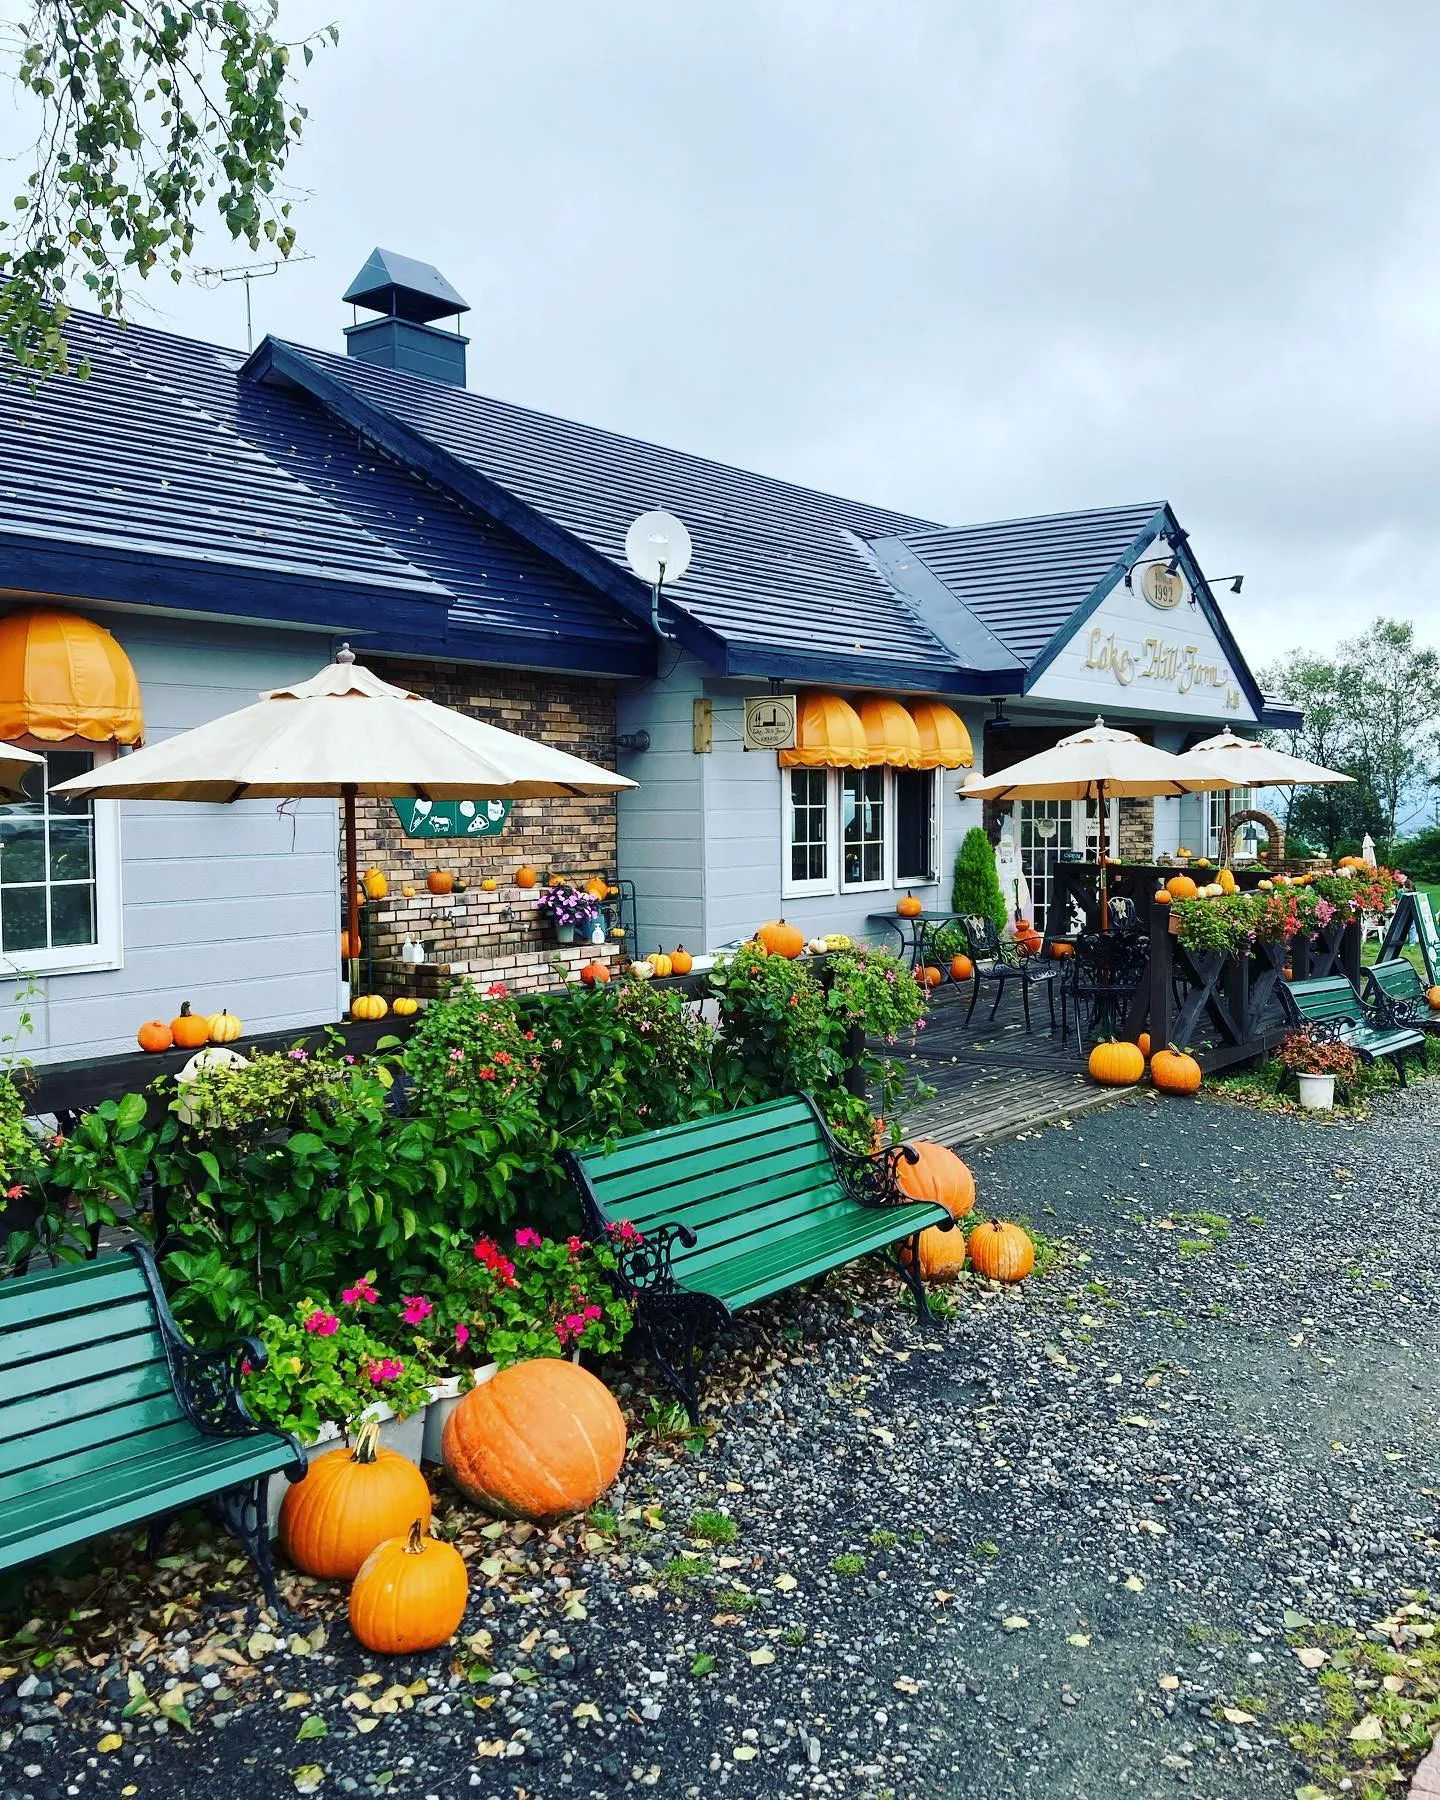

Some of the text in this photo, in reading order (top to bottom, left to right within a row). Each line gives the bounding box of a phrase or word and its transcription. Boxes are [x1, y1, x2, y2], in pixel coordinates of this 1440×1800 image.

[1154, 584, 1174, 603] 1992
[1080, 627, 1135, 686] Lake
[1178, 645, 1228, 694] Farm
